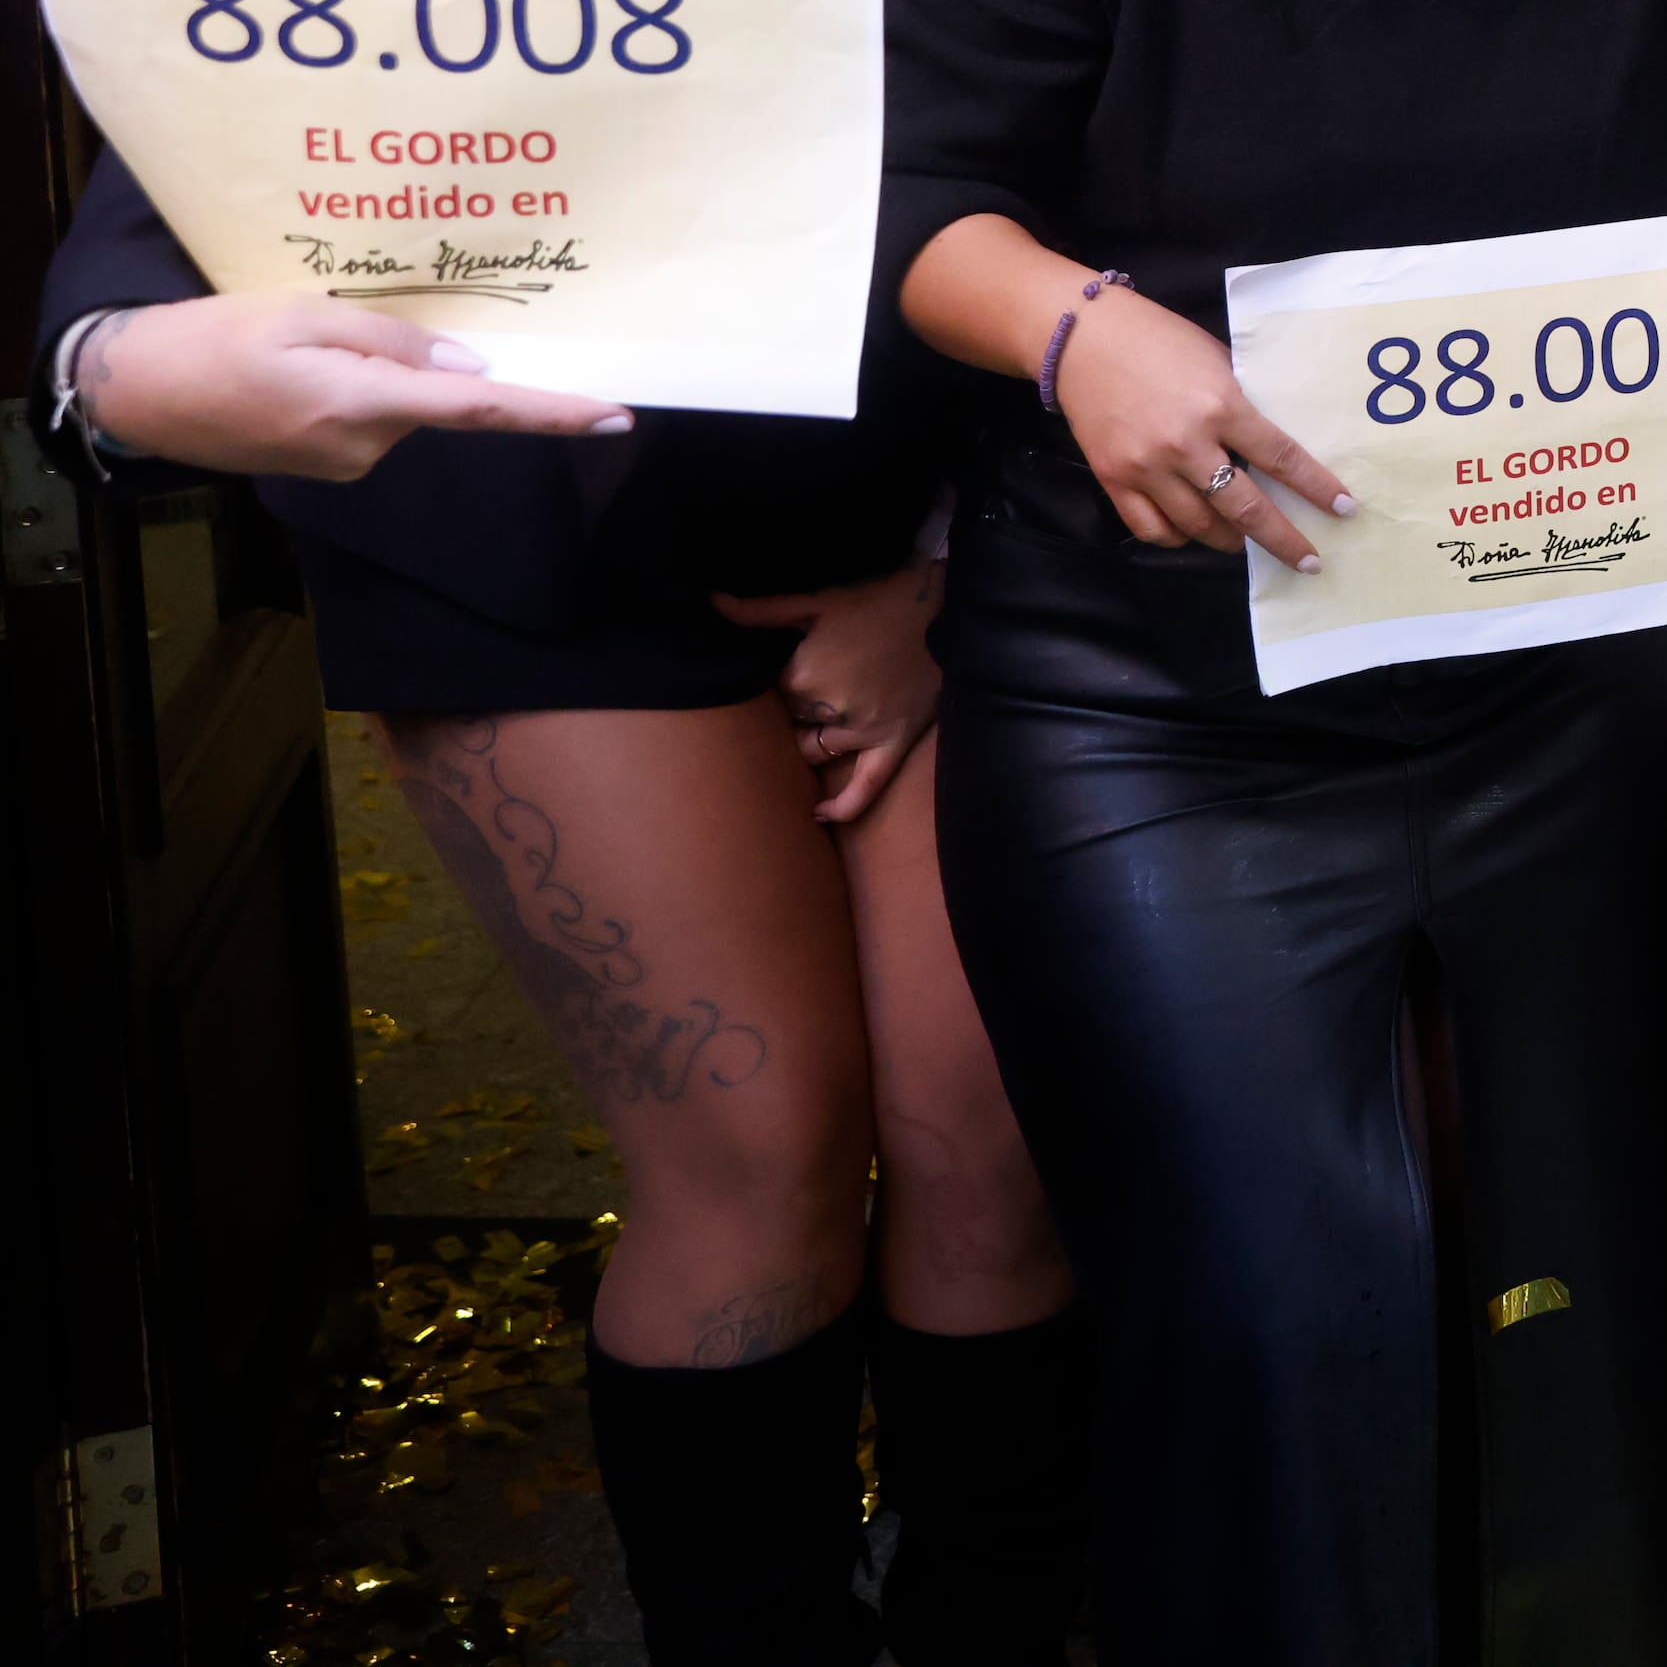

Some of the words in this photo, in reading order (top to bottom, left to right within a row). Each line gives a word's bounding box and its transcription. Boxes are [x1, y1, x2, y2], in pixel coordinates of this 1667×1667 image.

[304, 126, 357, 164] EL
[369, 130, 558, 166] GORDO
[298, 184, 497, 220] vendido
[511, 186, 570, 217] en
[1454, 458, 1494, 486] EL
[1501, 435, 1632, 478] GORDO
[1449, 486, 1590, 530] vendido
[1598, 479, 1638, 509] en
